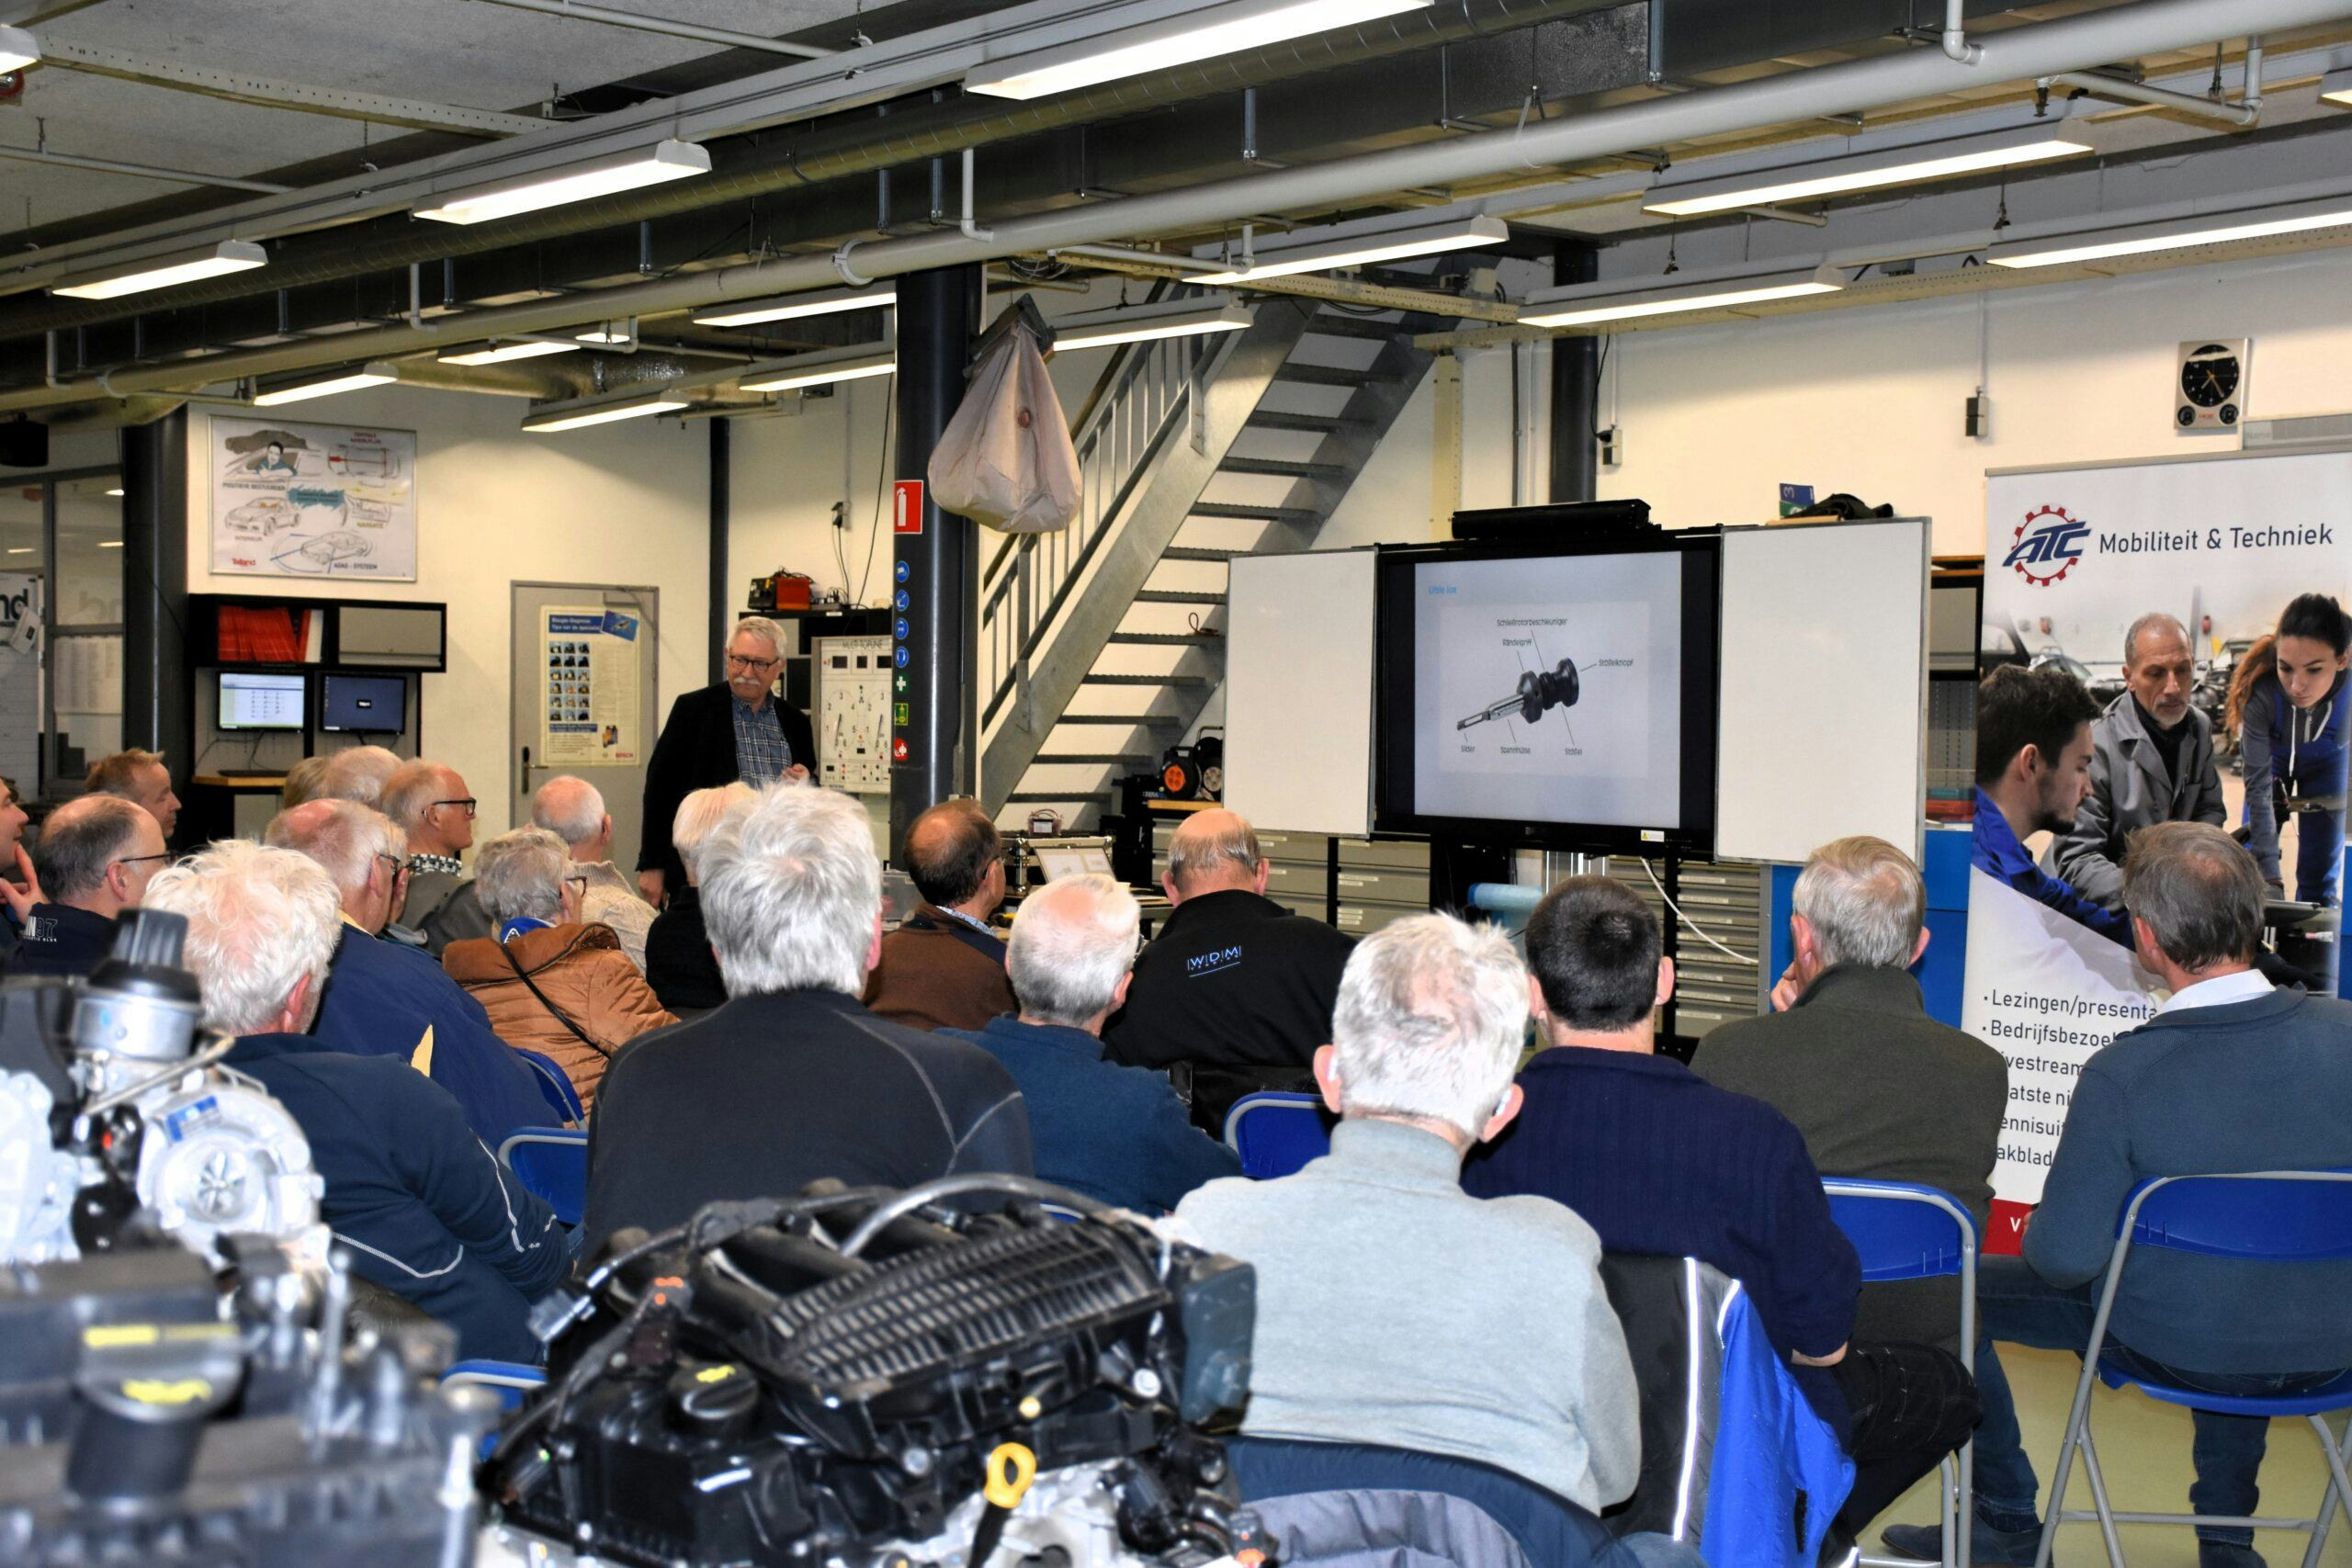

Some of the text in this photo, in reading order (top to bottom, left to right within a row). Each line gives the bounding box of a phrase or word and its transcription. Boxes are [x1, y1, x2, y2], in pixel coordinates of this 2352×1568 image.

[2002, 521, 2091, 567] ATC
[2099, 523, 2334, 554] Mobiliteit & Techniek
[2001, 1052, 2084, 1076] vestream
